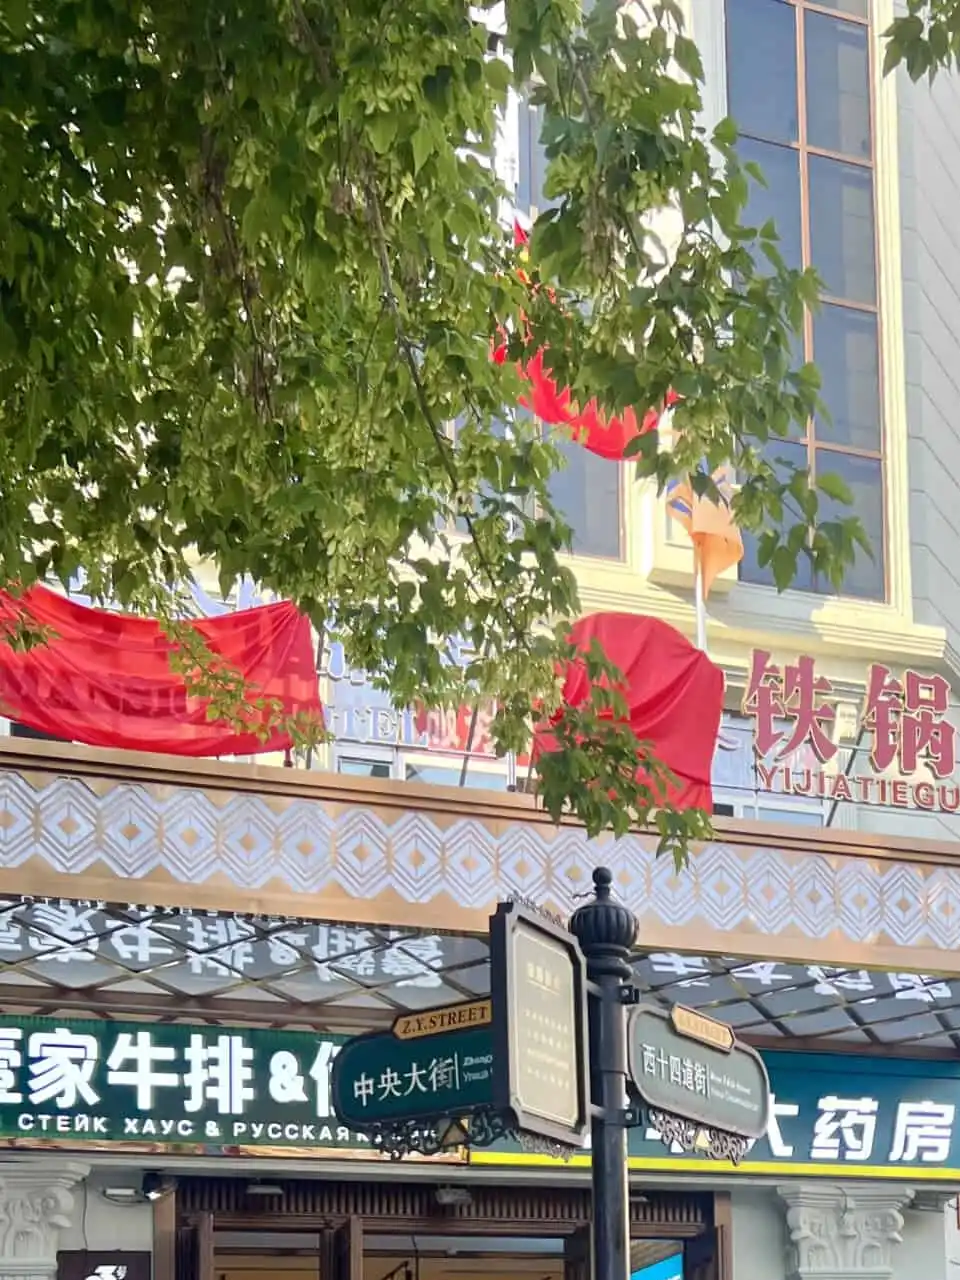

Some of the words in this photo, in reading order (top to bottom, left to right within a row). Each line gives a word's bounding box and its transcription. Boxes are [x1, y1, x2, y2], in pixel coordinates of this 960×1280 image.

[402, 1006, 489, 1035] Z.Y.STREET
[353, 1056, 454, 1107] 中央大街
[641, 1042, 706, 1097] 西十四道街
[18, 1113, 109, 1133] СТЕЙК
[124, 1118, 194, 1137] ХАУС
[205, 1120, 220, 1138] &
[233, 1122, 350, 1142] РУССКАЯ
